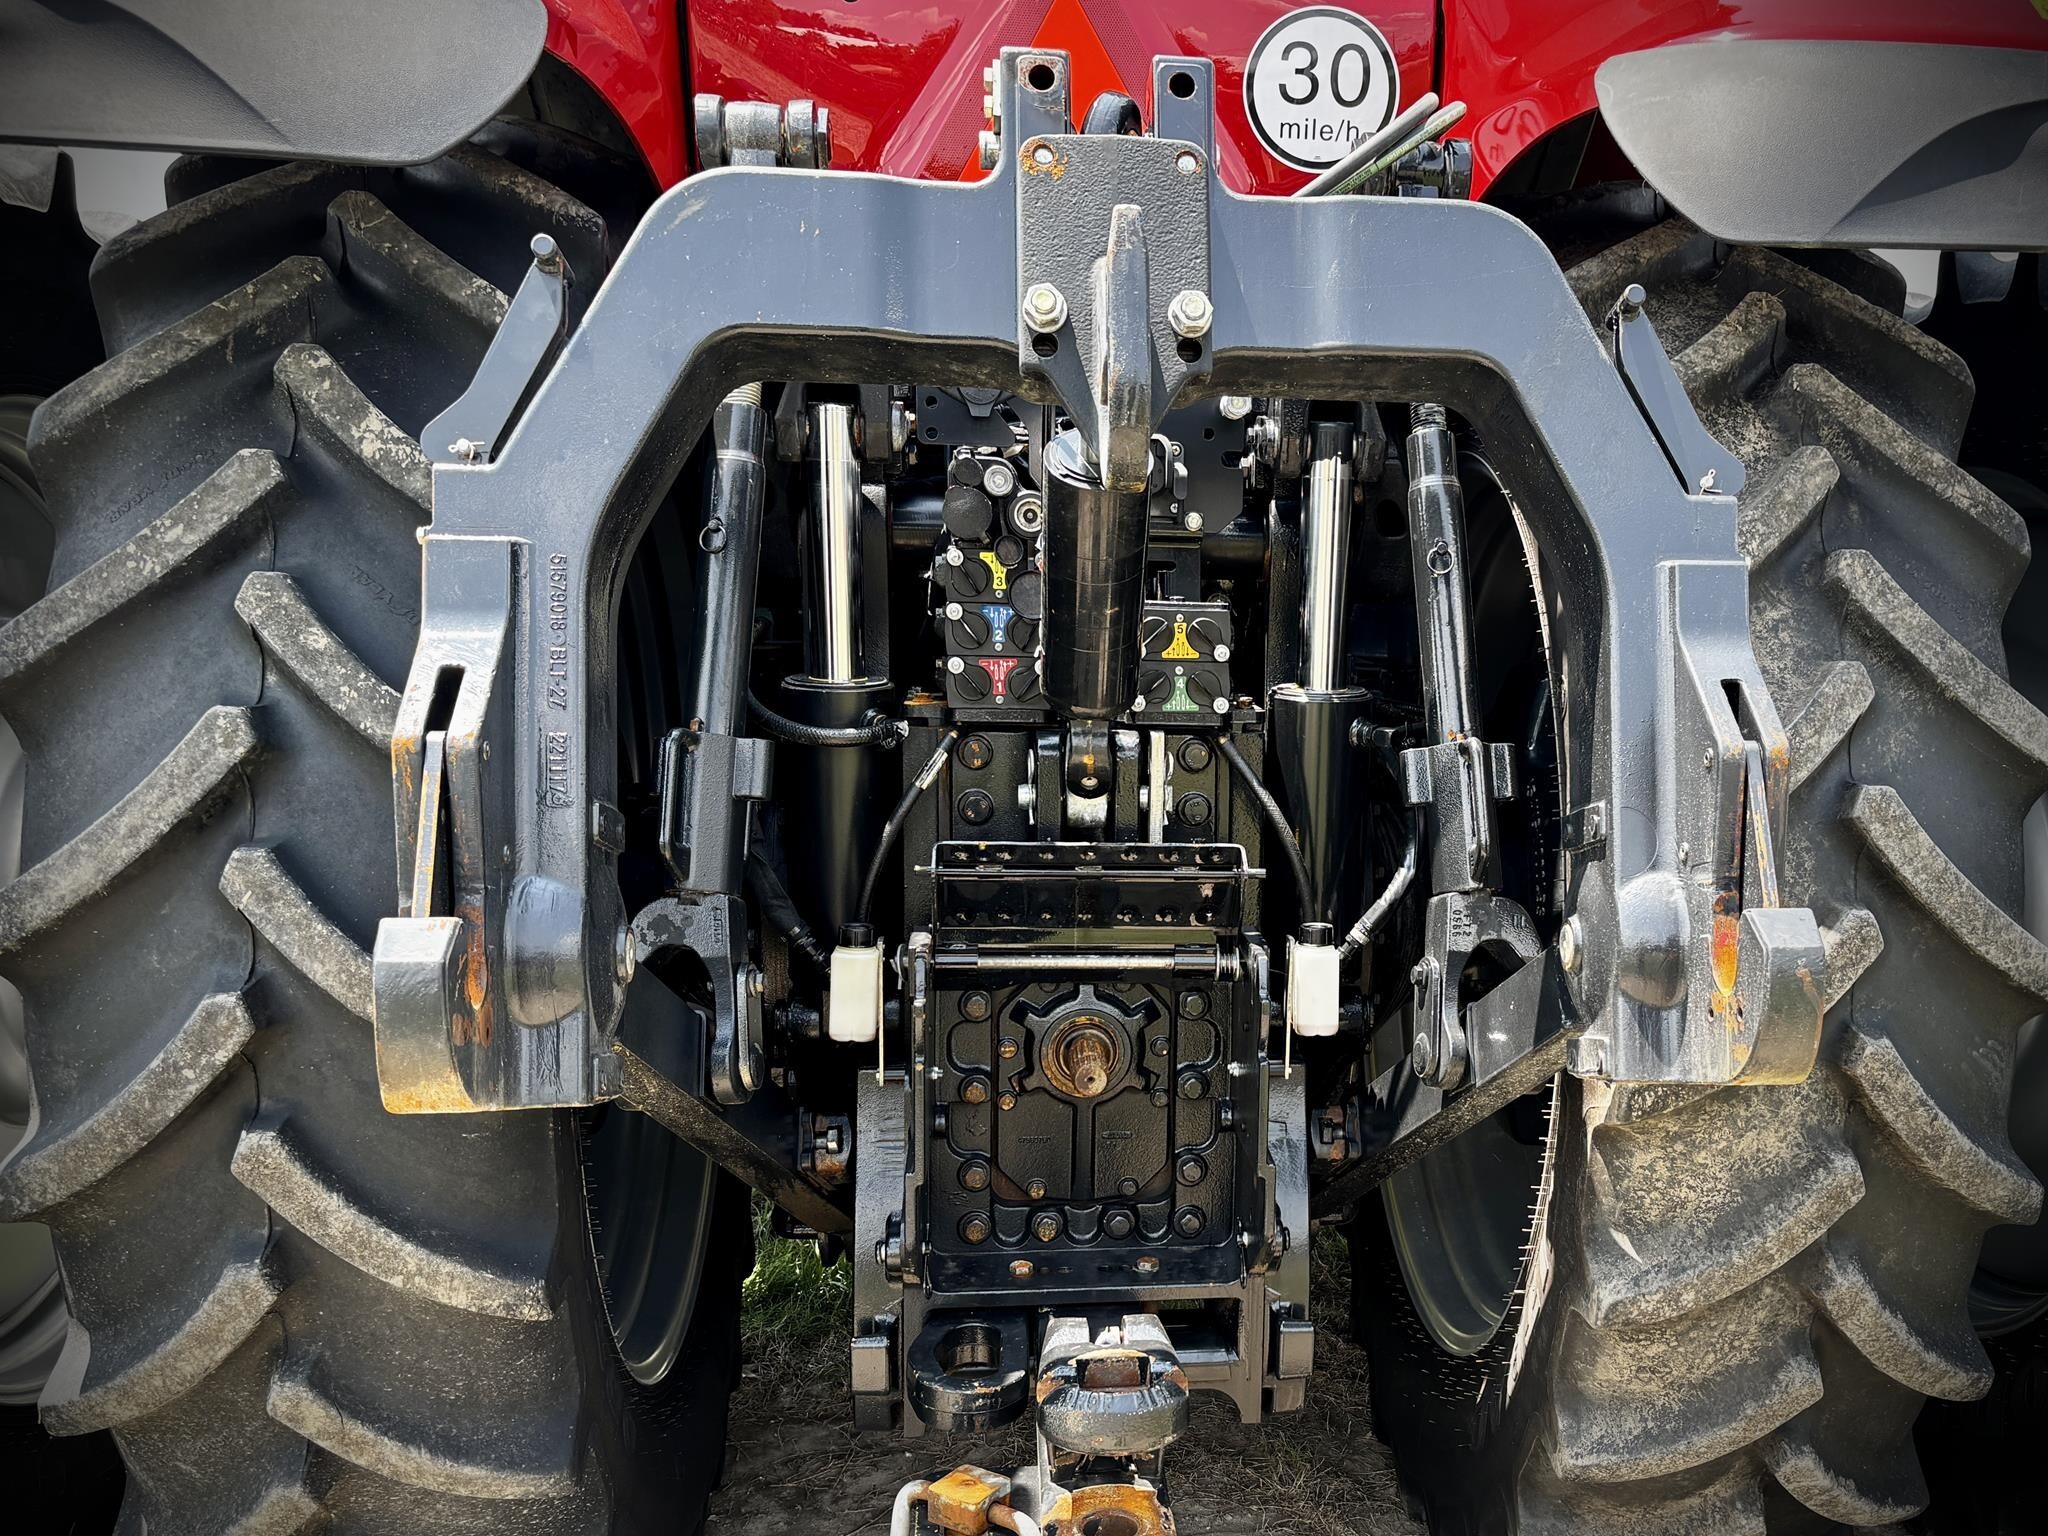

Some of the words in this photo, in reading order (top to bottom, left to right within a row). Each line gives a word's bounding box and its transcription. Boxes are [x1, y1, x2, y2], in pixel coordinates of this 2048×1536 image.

[1278, 41, 1371, 108] 30
[1279, 118, 1360, 142] mile/h
[996, 576, 1003, 587] 3
[1177, 624, 1184, 634] 5
[995, 630, 1003, 640] 2
[996, 681, 1002, 692] 1
[1177, 678, 1184, 689] 4
